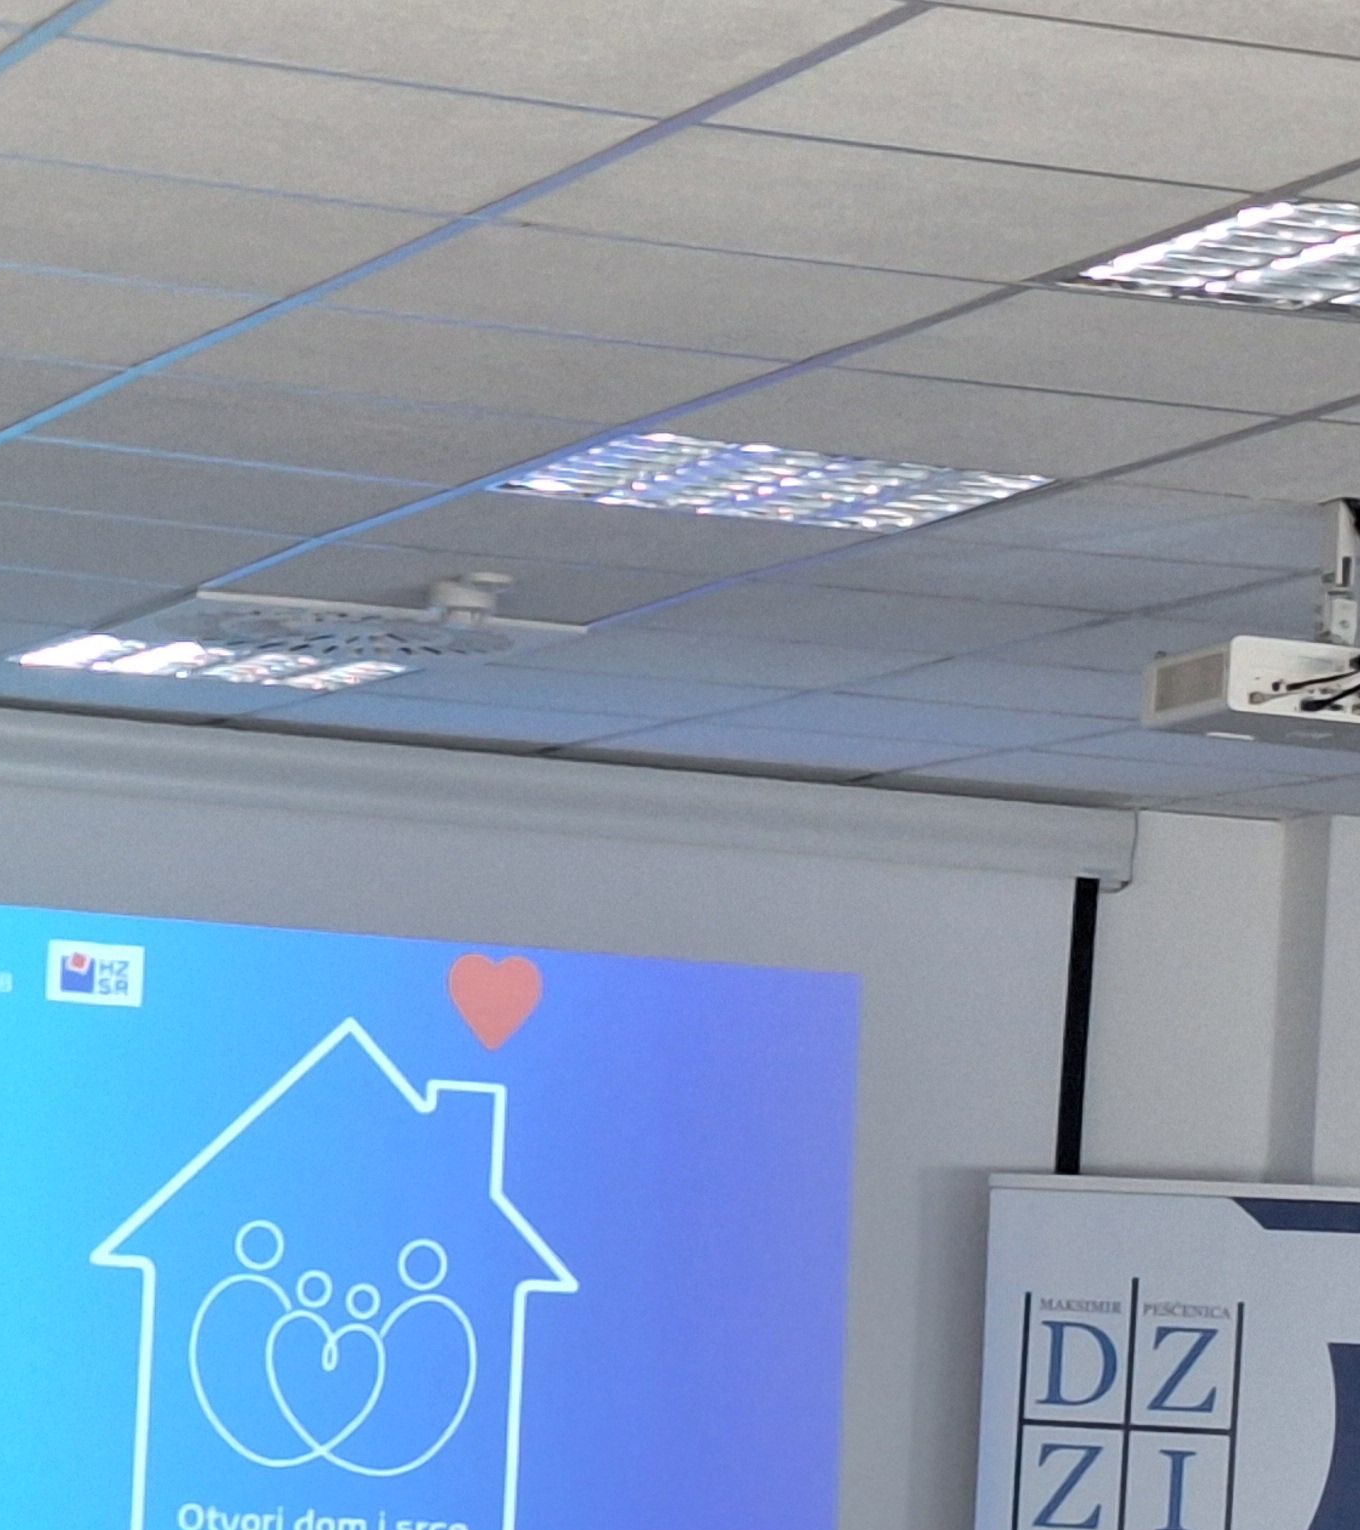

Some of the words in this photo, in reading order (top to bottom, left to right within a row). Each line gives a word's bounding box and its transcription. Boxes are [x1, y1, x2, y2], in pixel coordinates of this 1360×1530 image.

[1040, 1298, 1122, 1314] MAKSIMIR
[1035, 1320, 1118, 1406] D
[1147, 1326, 1219, 1413] Z
[1032, 1443, 1104, 1530] Z
